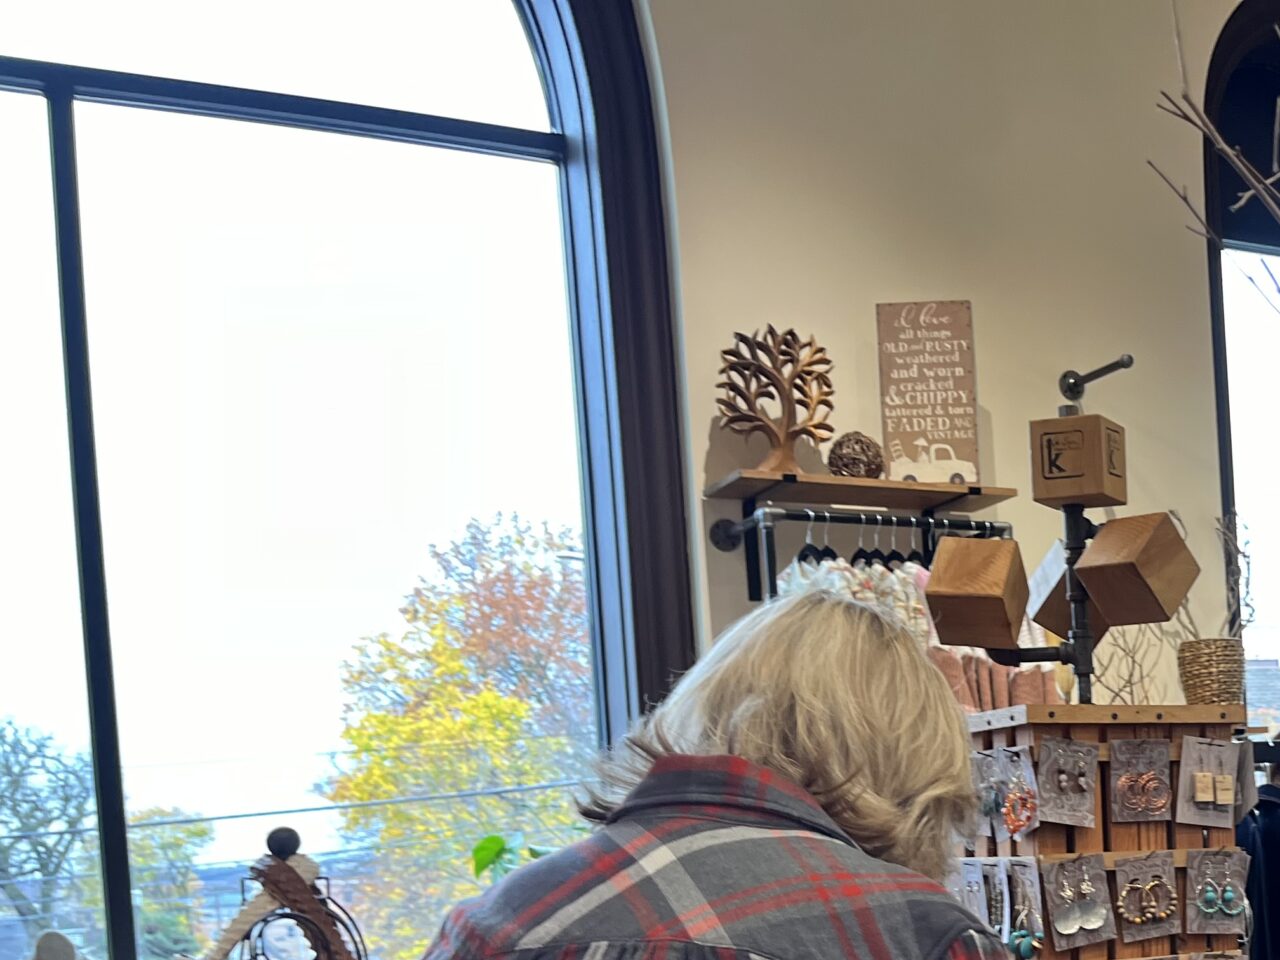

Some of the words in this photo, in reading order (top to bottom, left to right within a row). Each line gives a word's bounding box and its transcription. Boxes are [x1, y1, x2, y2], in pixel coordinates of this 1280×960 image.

[919, 302, 952, 327] love
[899, 328, 915, 339] all
[916, 328, 952, 340] things
[882, 341, 908, 353] OLD
[925, 339, 968, 352] RUSTY
[895, 351, 960, 364] weathered
[890, 363, 918, 378] and
[922, 367, 965, 377] worn
[900, 377, 955, 392] cracked
[905, 390, 968, 405] CHIPPY
[884, 405, 932, 417] tattered
[934, 405, 945, 415] &
[946, 405, 975, 415] torn
[886, 417, 951, 433] FADED
[927, 430, 975, 440] VINTAGE
